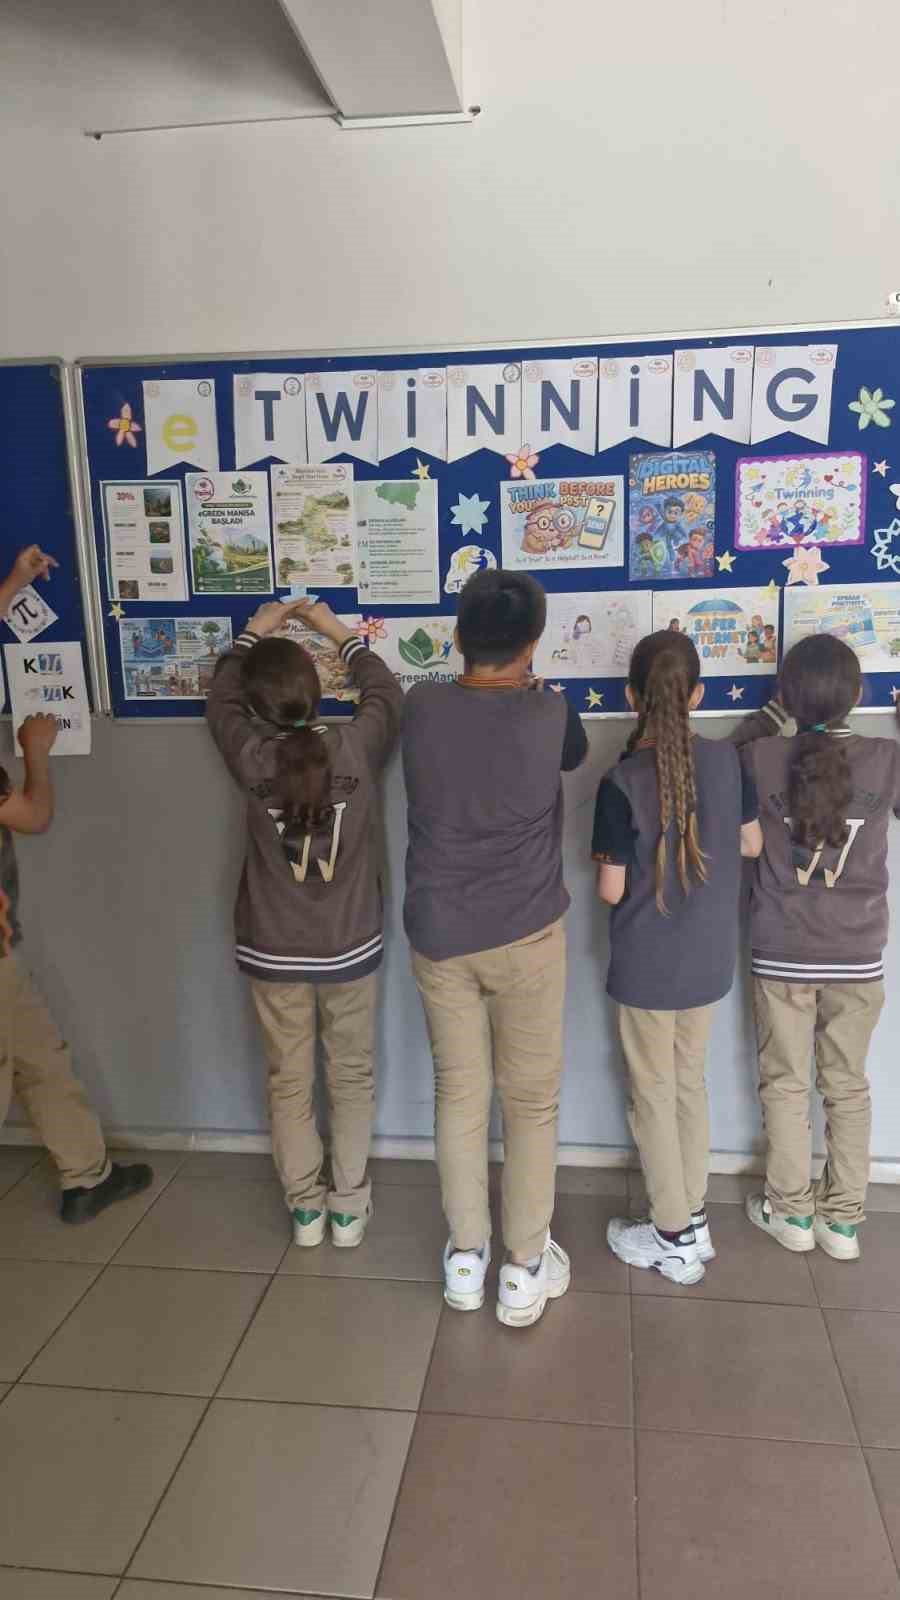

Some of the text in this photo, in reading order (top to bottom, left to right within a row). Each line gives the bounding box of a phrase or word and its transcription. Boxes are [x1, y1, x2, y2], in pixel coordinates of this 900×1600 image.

[638, 458, 711, 478] DIGITAL
[508, 481, 615, 502] THINK BEFORE
[642, 473, 711, 496] HEROES
[694, 618, 737, 631] SAFER
